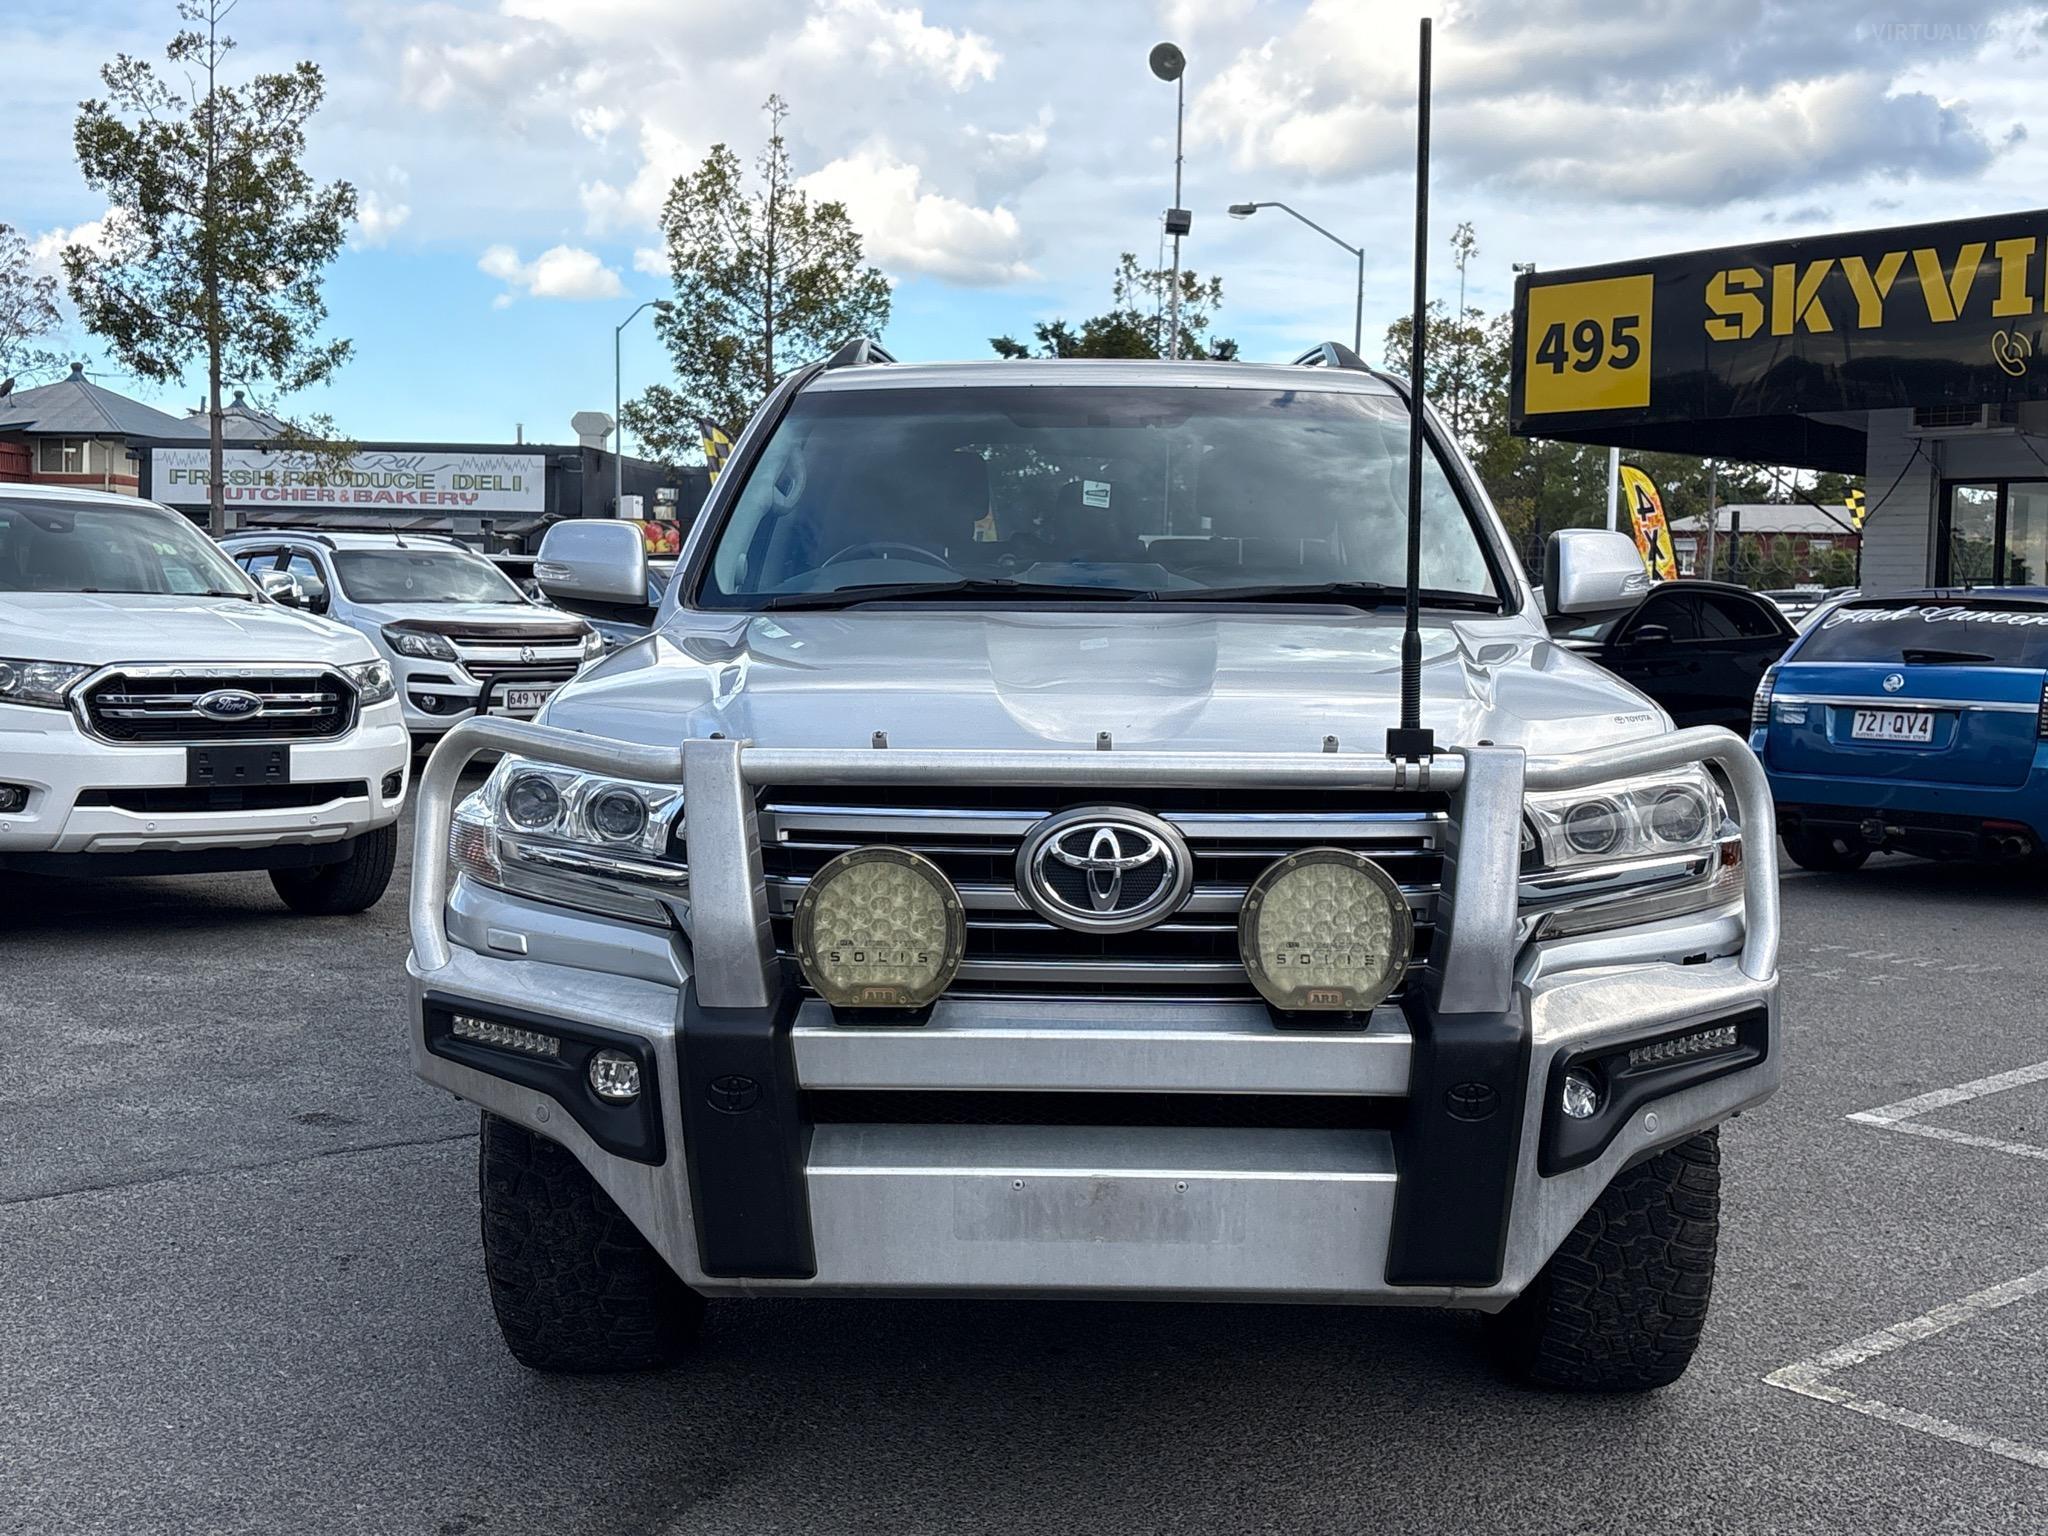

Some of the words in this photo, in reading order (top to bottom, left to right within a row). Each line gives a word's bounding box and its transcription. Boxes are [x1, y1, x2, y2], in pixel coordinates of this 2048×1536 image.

[1704, 235, 2048, 341] SKYVI
[1535, 315, 1640, 374] 495
[350, 454, 427, 472] Roll
[206, 487, 336, 502] UTCHER
[339, 489, 350, 502] &
[353, 490, 479, 505] BAKERY
[216, 696, 249, 711] Ford
[1624, 714, 1653, 723] TOYOTA
[830, 951, 928, 963] SOLIS
[1276, 953, 1375, 966] SOLIS
[1311, 994, 1339, 1004] ARB
